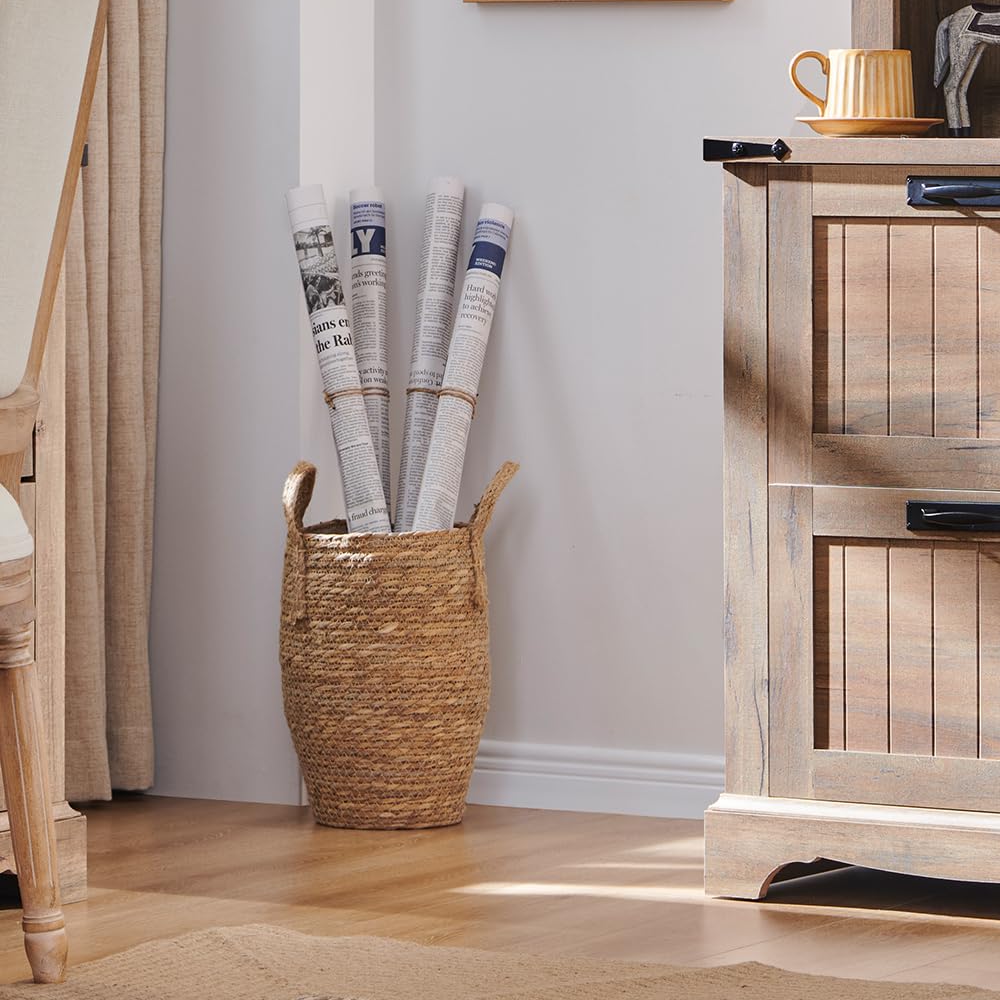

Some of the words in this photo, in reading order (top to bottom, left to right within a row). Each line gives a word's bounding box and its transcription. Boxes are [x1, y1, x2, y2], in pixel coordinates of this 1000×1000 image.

[466, 284, 485, 293] Hard
[460, 313, 487, 327] recovery
[316, 340, 330, 353] the
[351, 508, 368, 521] fraud
